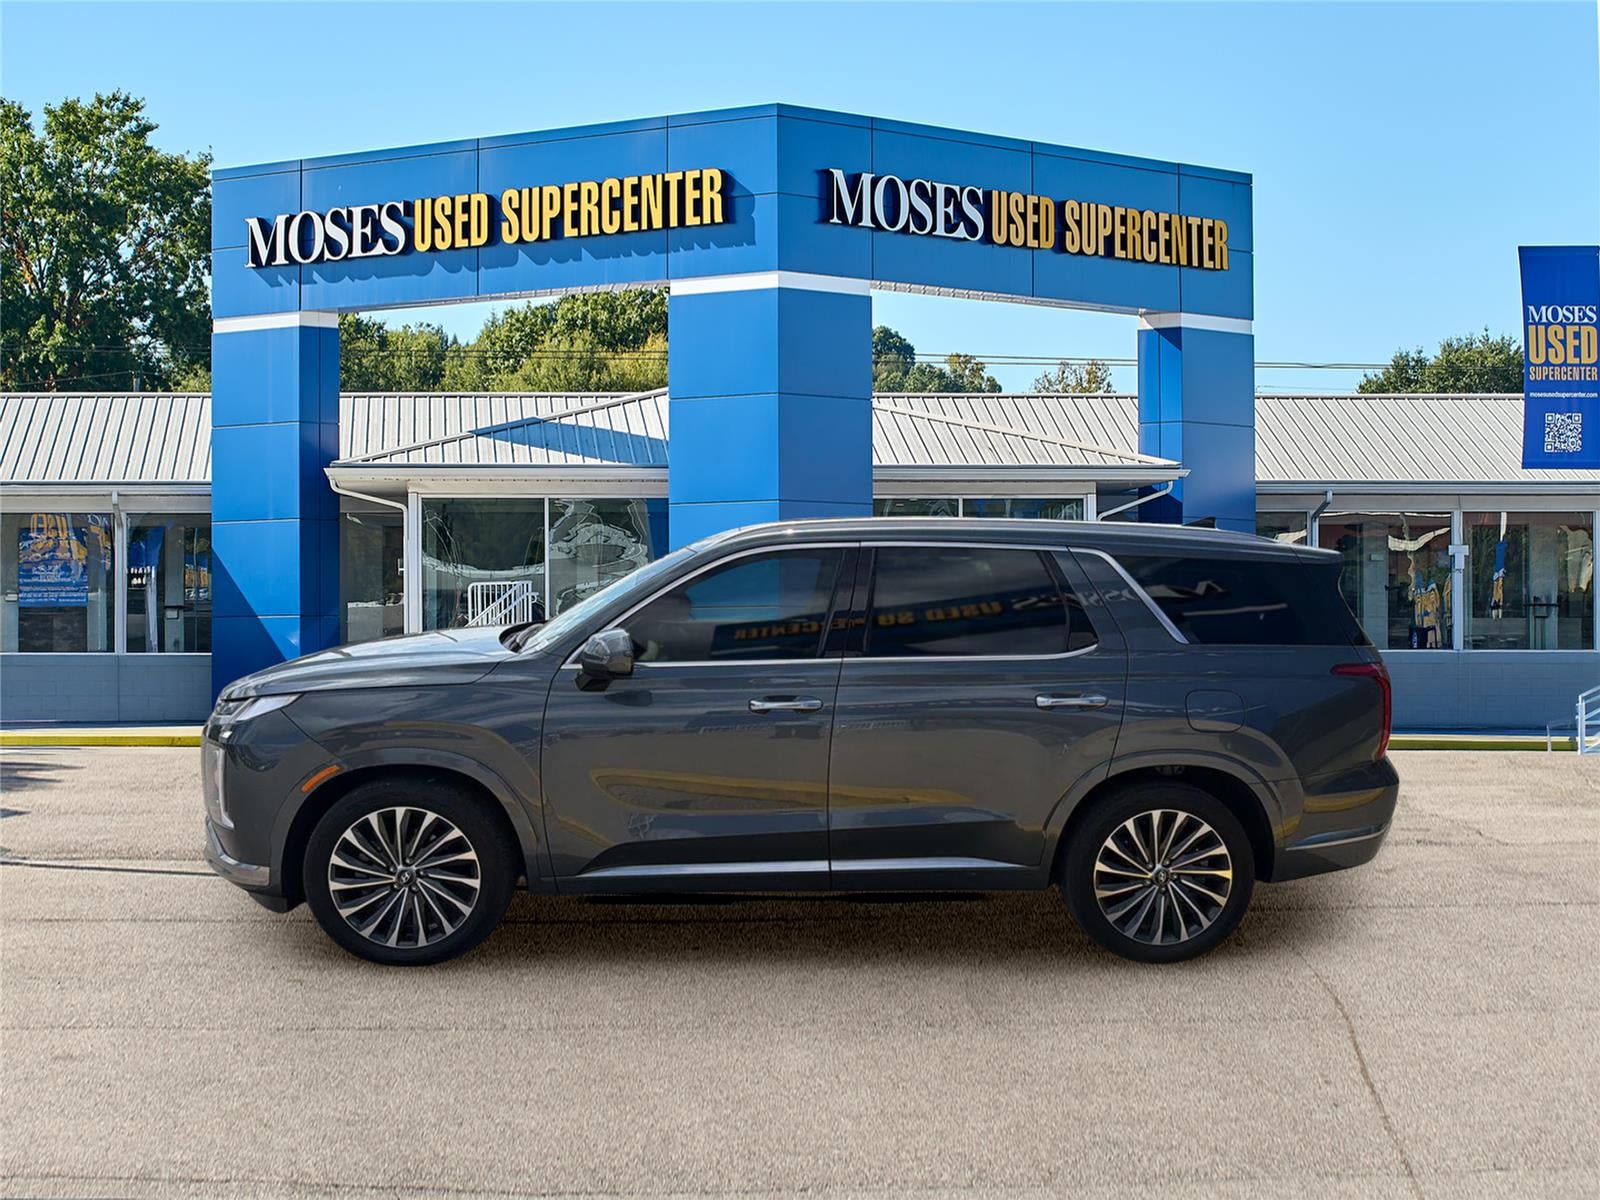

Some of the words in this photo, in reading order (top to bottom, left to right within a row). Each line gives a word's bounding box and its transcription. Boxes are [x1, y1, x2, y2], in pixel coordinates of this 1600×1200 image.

[244, 201, 407, 268] MOSES
[413, 193, 488, 251] USED
[501, 168, 723, 244] SUPERCENTER
[829, 168, 984, 240] MOSES
[991, 190, 1055, 249] USED
[1065, 200, 1229, 270] SUPERCENTER
[1528, 305, 1597, 323] MOSES
[1528, 325, 1598, 364] USED
[1529, 366, 1598, 381] SUPERCENTER
